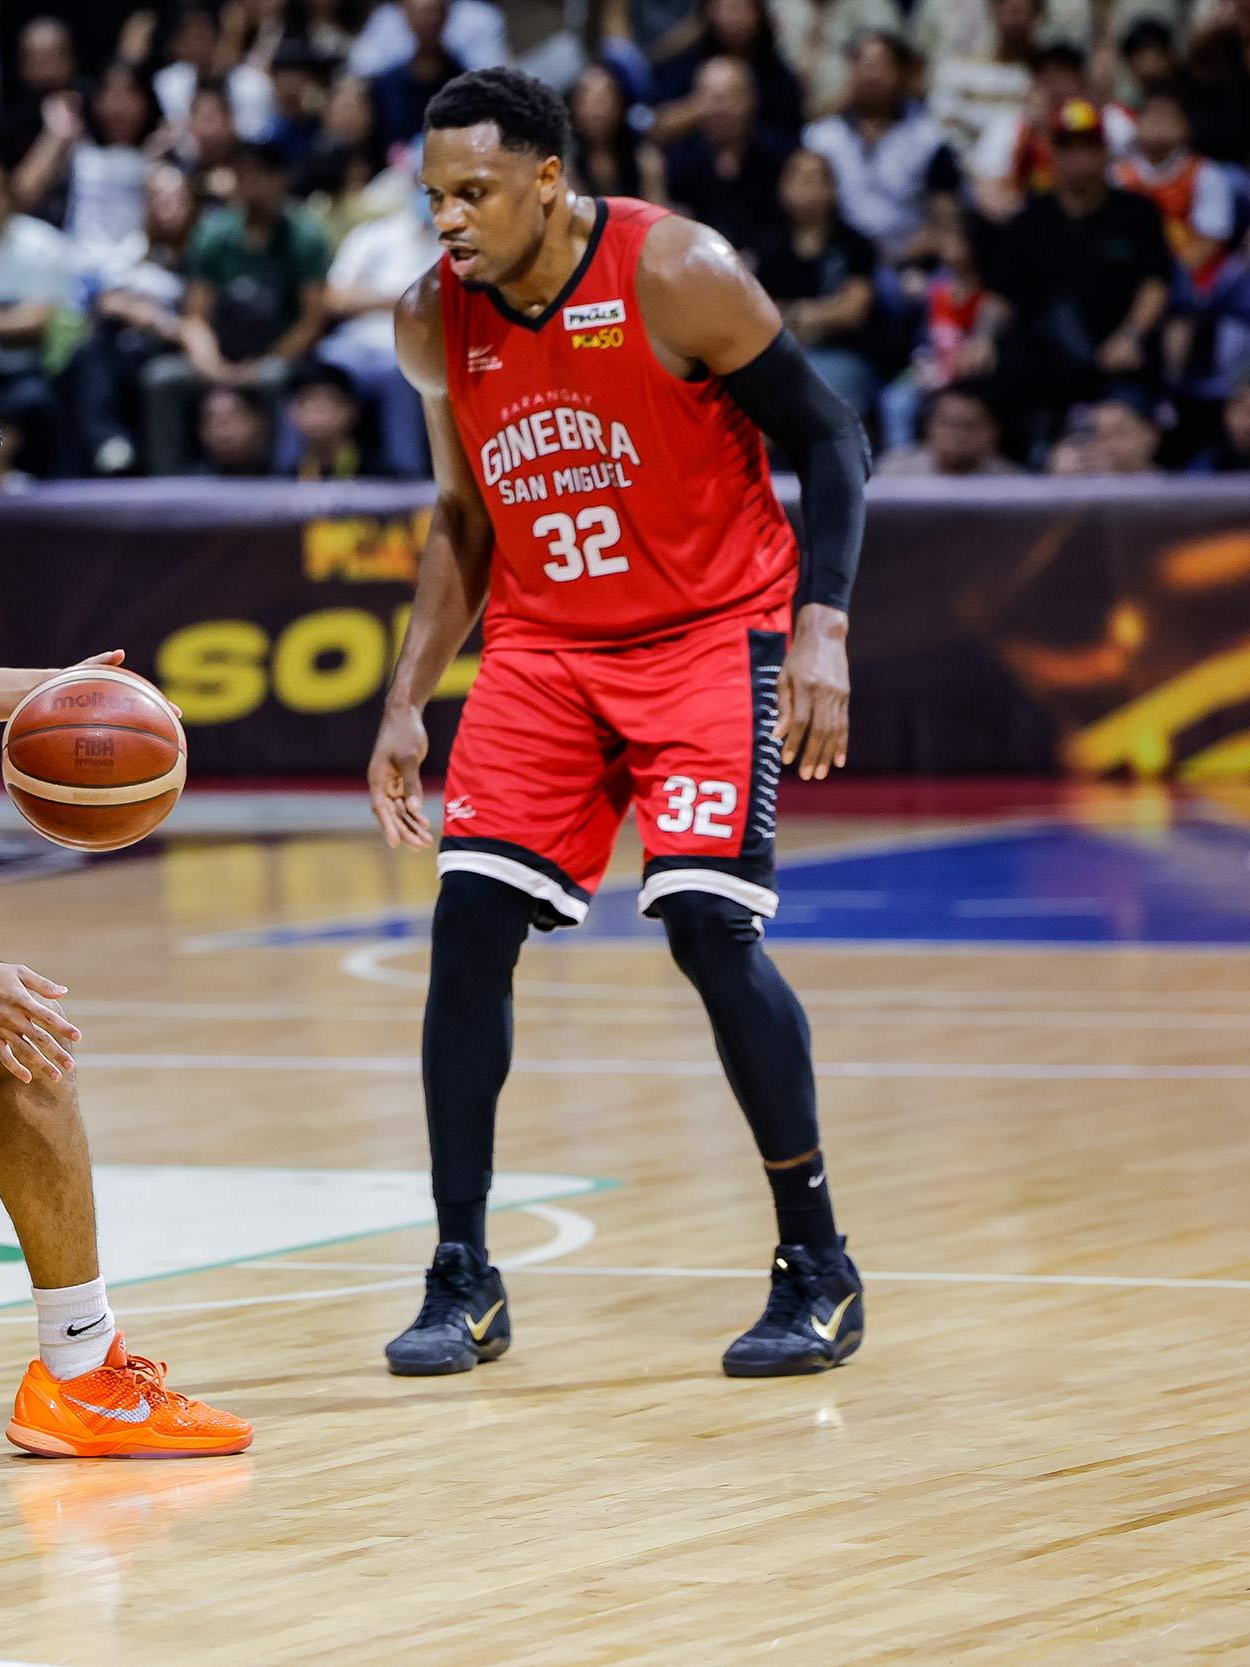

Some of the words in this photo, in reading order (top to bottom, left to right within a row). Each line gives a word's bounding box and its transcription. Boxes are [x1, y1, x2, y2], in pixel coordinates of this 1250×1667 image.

[480, 406, 641, 487] GINEBRA
[499, 473, 549, 505] SAN
[532, 505, 630, 582] 32
[74, 737, 115, 757] FIBA
[656, 774, 739, 839] 32
